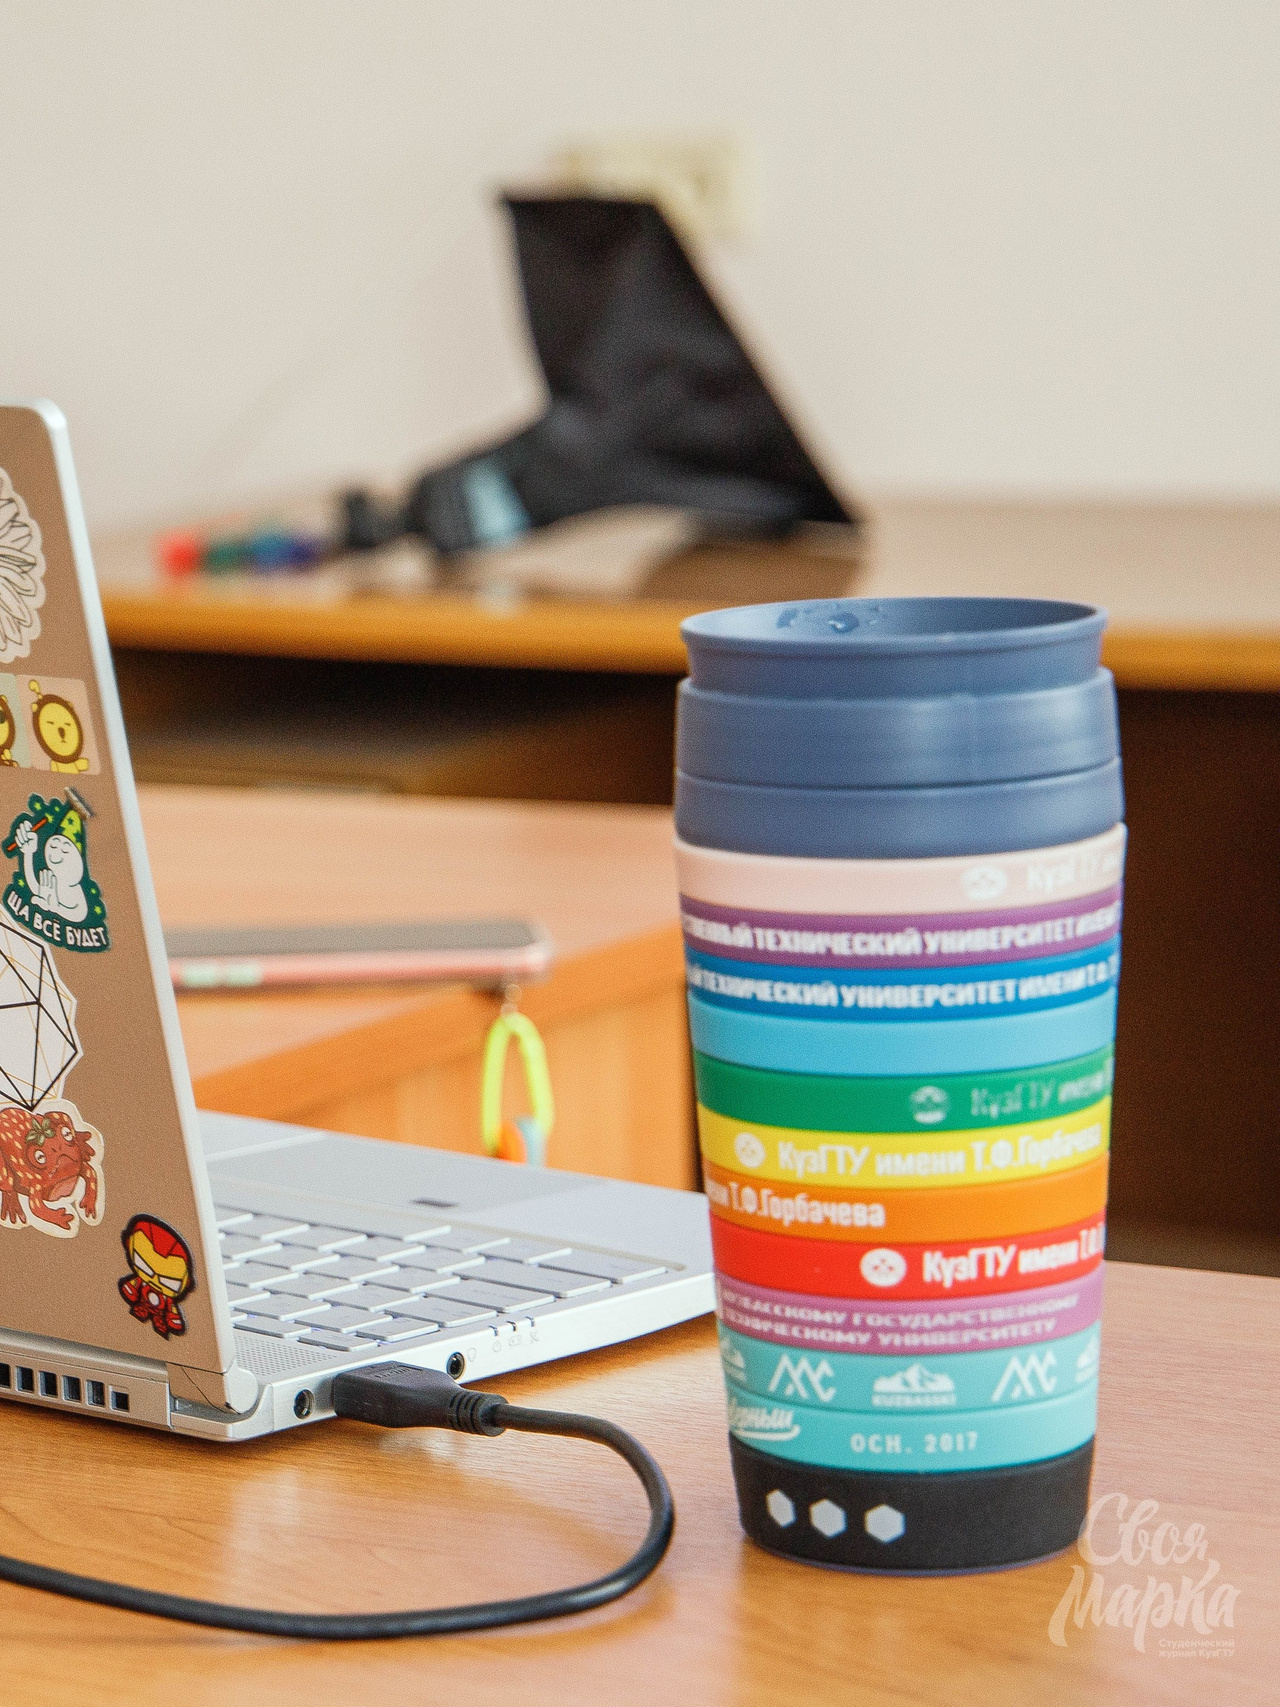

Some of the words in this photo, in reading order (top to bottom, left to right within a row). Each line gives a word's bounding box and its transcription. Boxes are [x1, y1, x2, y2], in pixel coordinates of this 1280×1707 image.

[7, 890, 30, 922] ЩА
[33, 912, 61, 942] ВСЁ
[65, 926, 107, 947] БУДЕТ
[754, 926, 922, 956] ТЕХНИЧЕСКИЙ
[923, 916, 1076, 954] УНИВЕРСИТЕТ
[702, 969, 839, 1006] ТЕХНИЧЕСКИЙ
[839, 978, 1016, 1009] УНИВЕРСИТЕТ
[778, 1141, 871, 1179] КузГТУ
[875, 1151, 966, 1176] имени
[922, 1244, 1017, 1289] КузГТУ
[1018, 1239, 1079, 1274] имени
[850, 1432, 912, 1454] ОСН.
[923, 1430, 979, 1454] 2017
